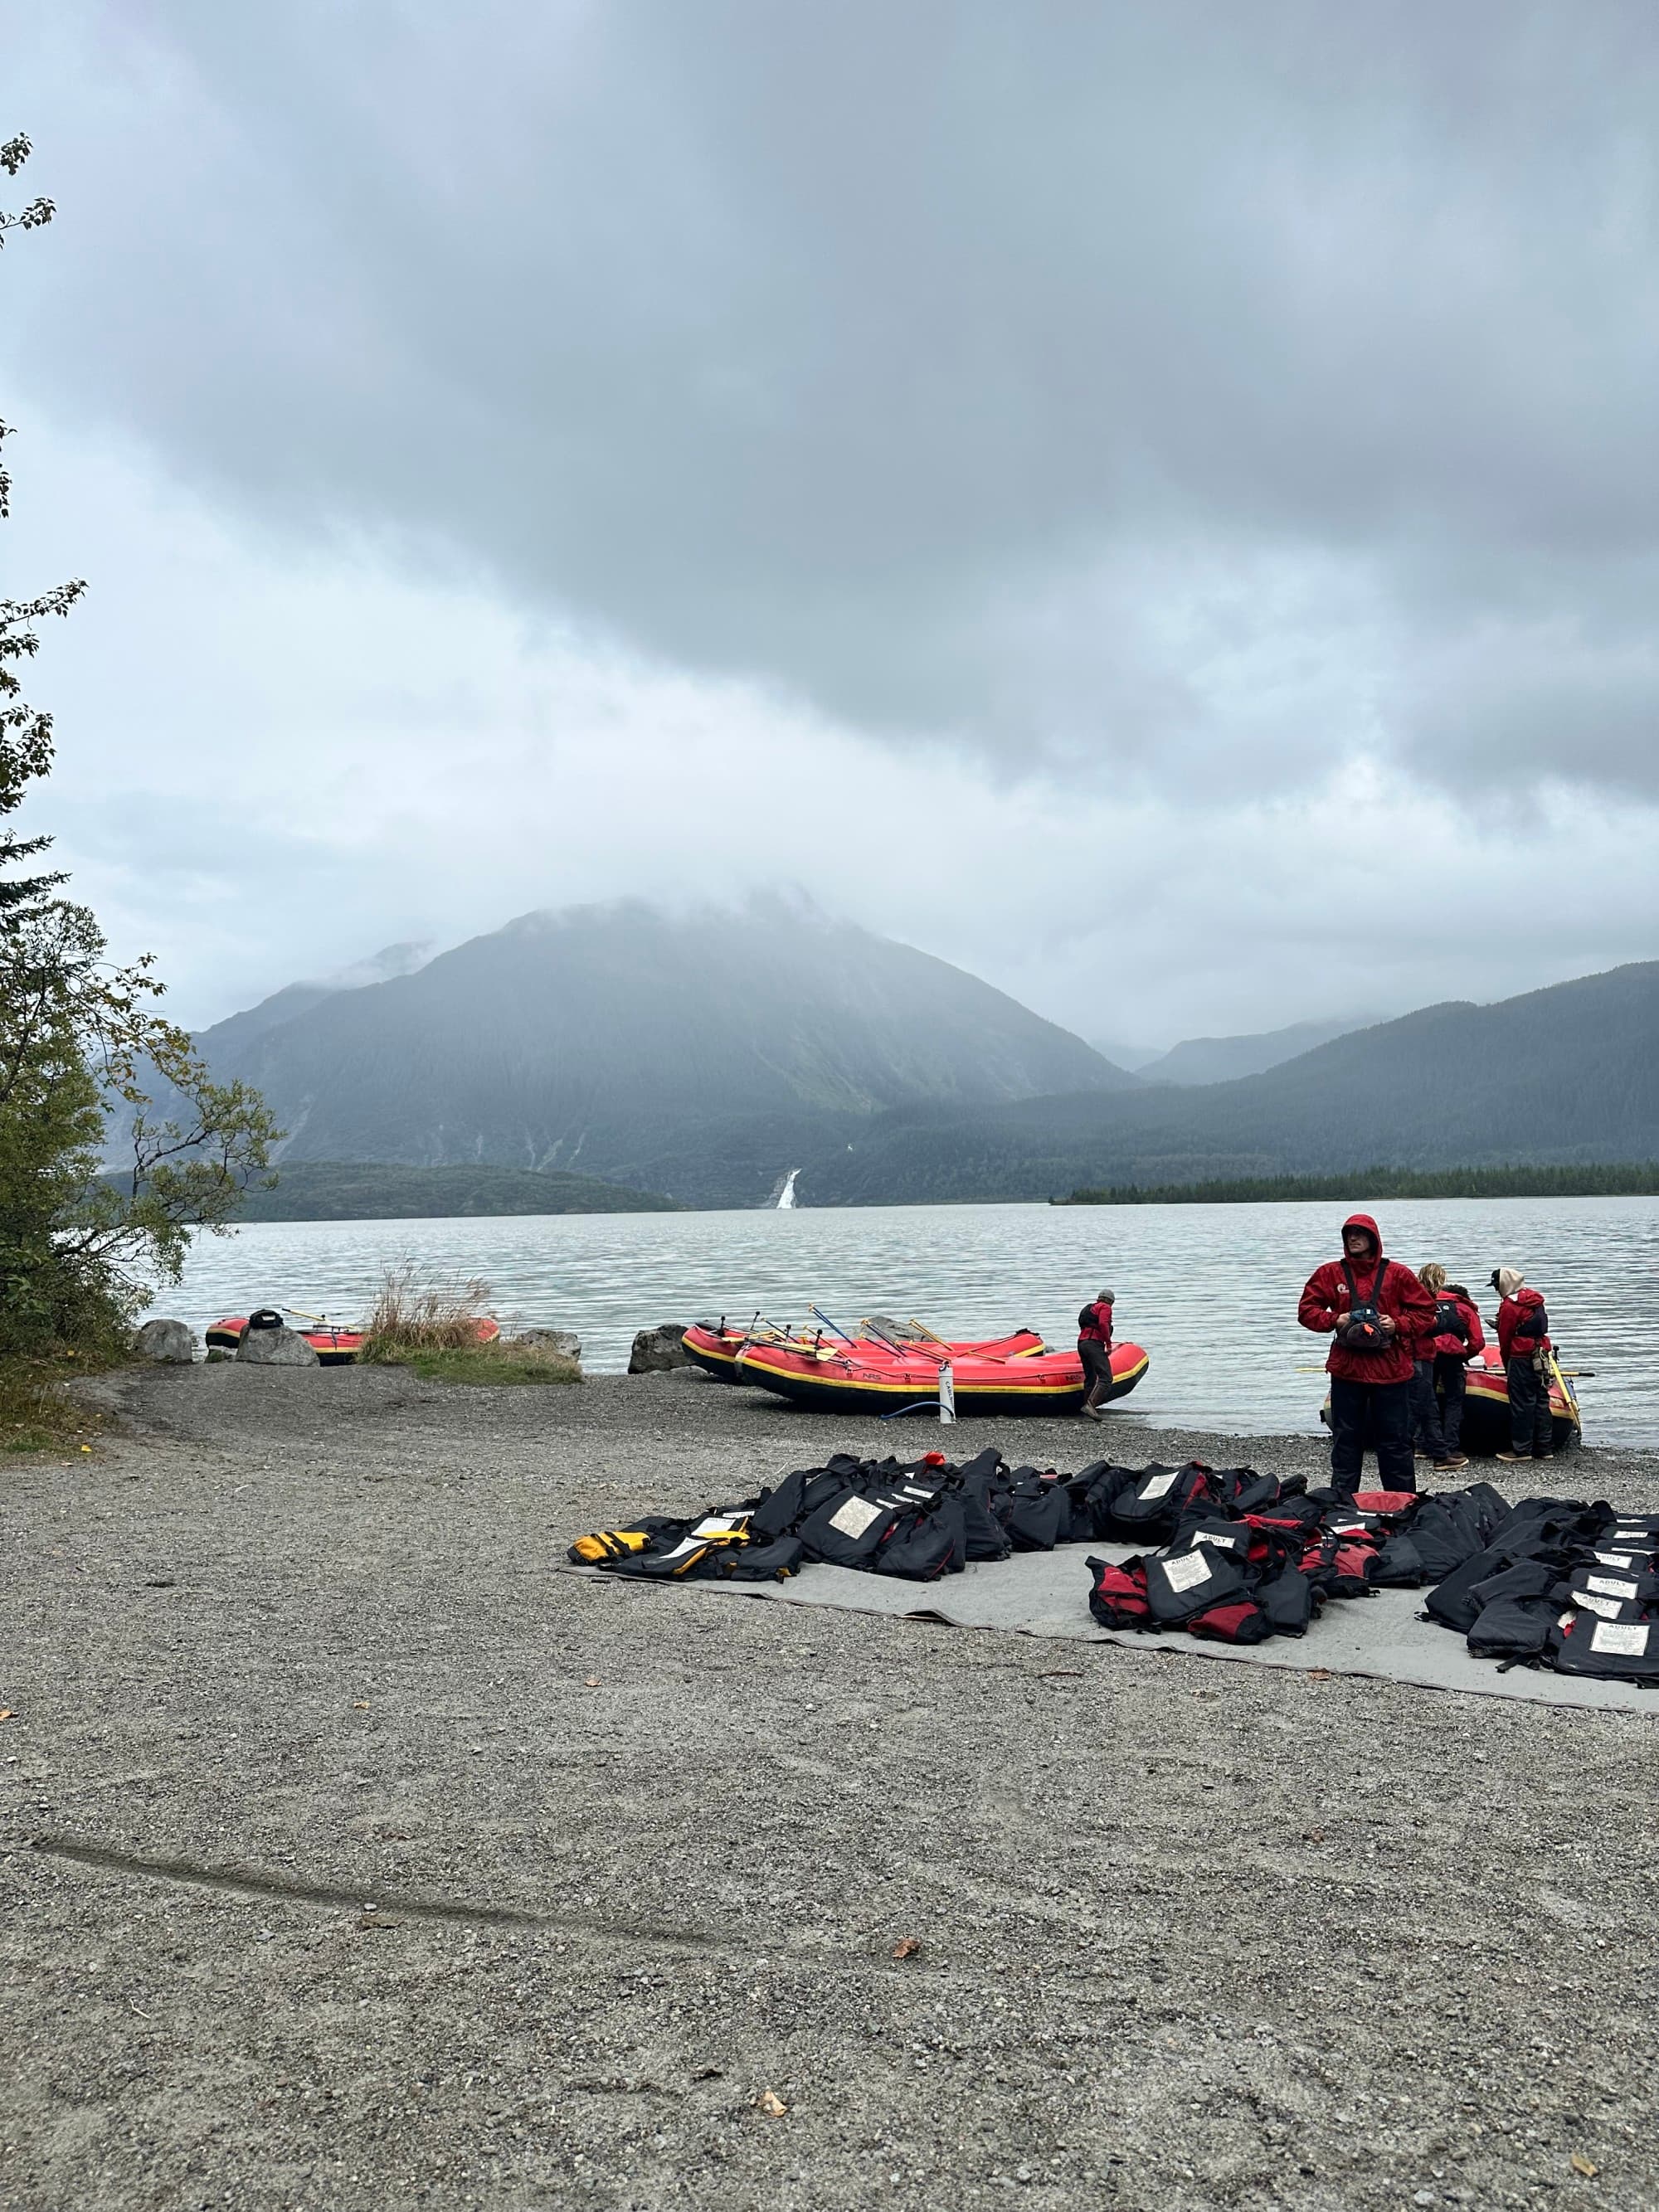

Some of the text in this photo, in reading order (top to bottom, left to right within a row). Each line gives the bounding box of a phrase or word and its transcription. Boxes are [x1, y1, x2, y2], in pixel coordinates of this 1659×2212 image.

[1203, 1534, 1226, 1544] ADULT
[1171, 1554, 1194, 1565] ADULT
[1583, 1595, 1609, 1607] ADULT
